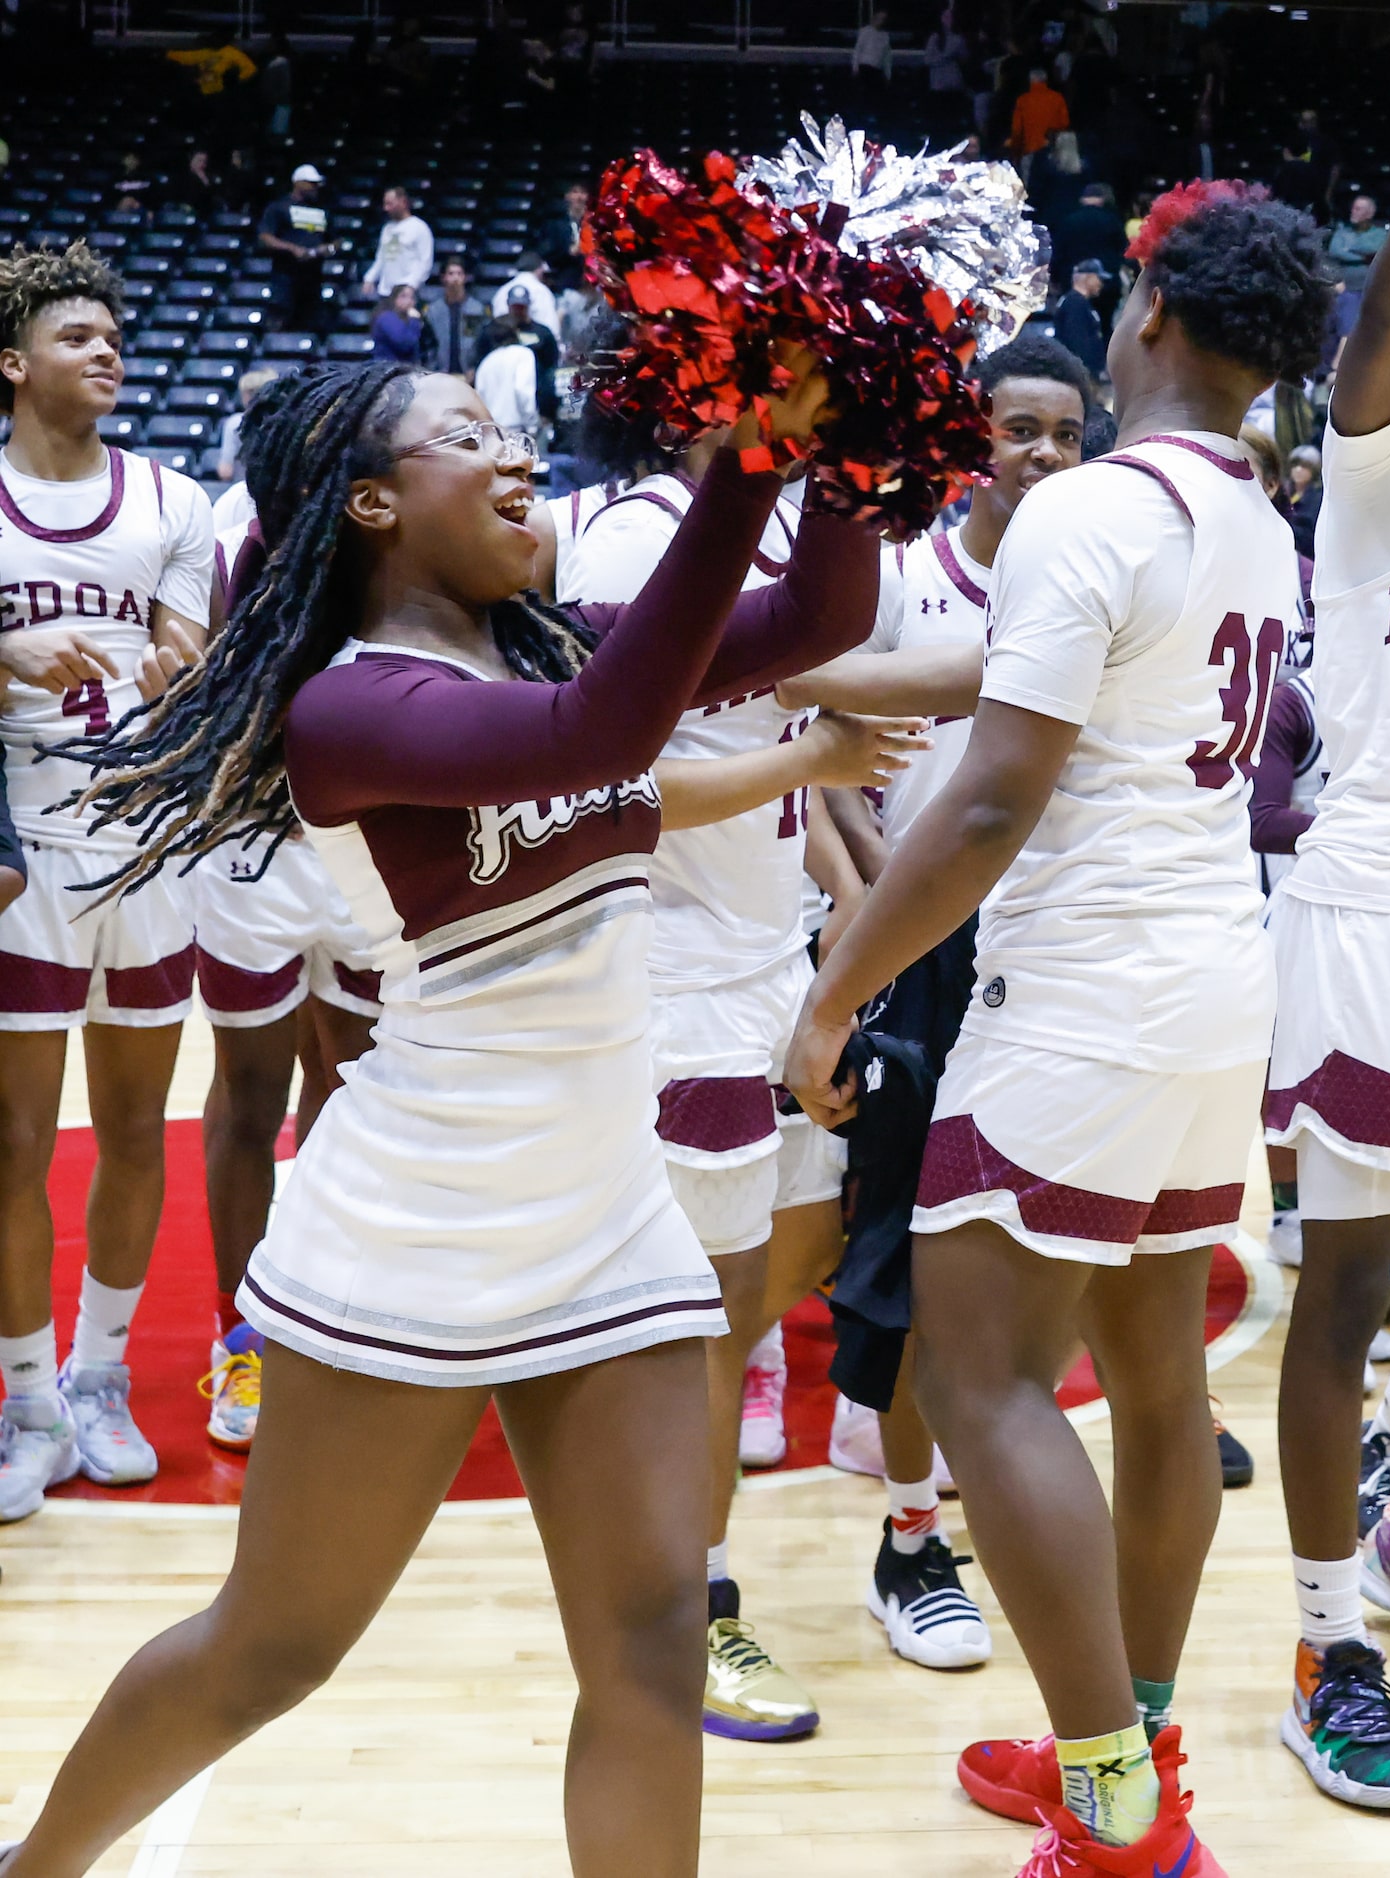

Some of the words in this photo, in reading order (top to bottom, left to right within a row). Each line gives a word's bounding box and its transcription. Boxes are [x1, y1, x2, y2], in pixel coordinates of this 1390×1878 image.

[0, 581, 63, 633] ED
[75, 582, 156, 629] OA
[62, 677, 112, 736] 4
[1185, 611, 1285, 790] 30
[1098, 1781, 1115, 1829] ORIGINAL
